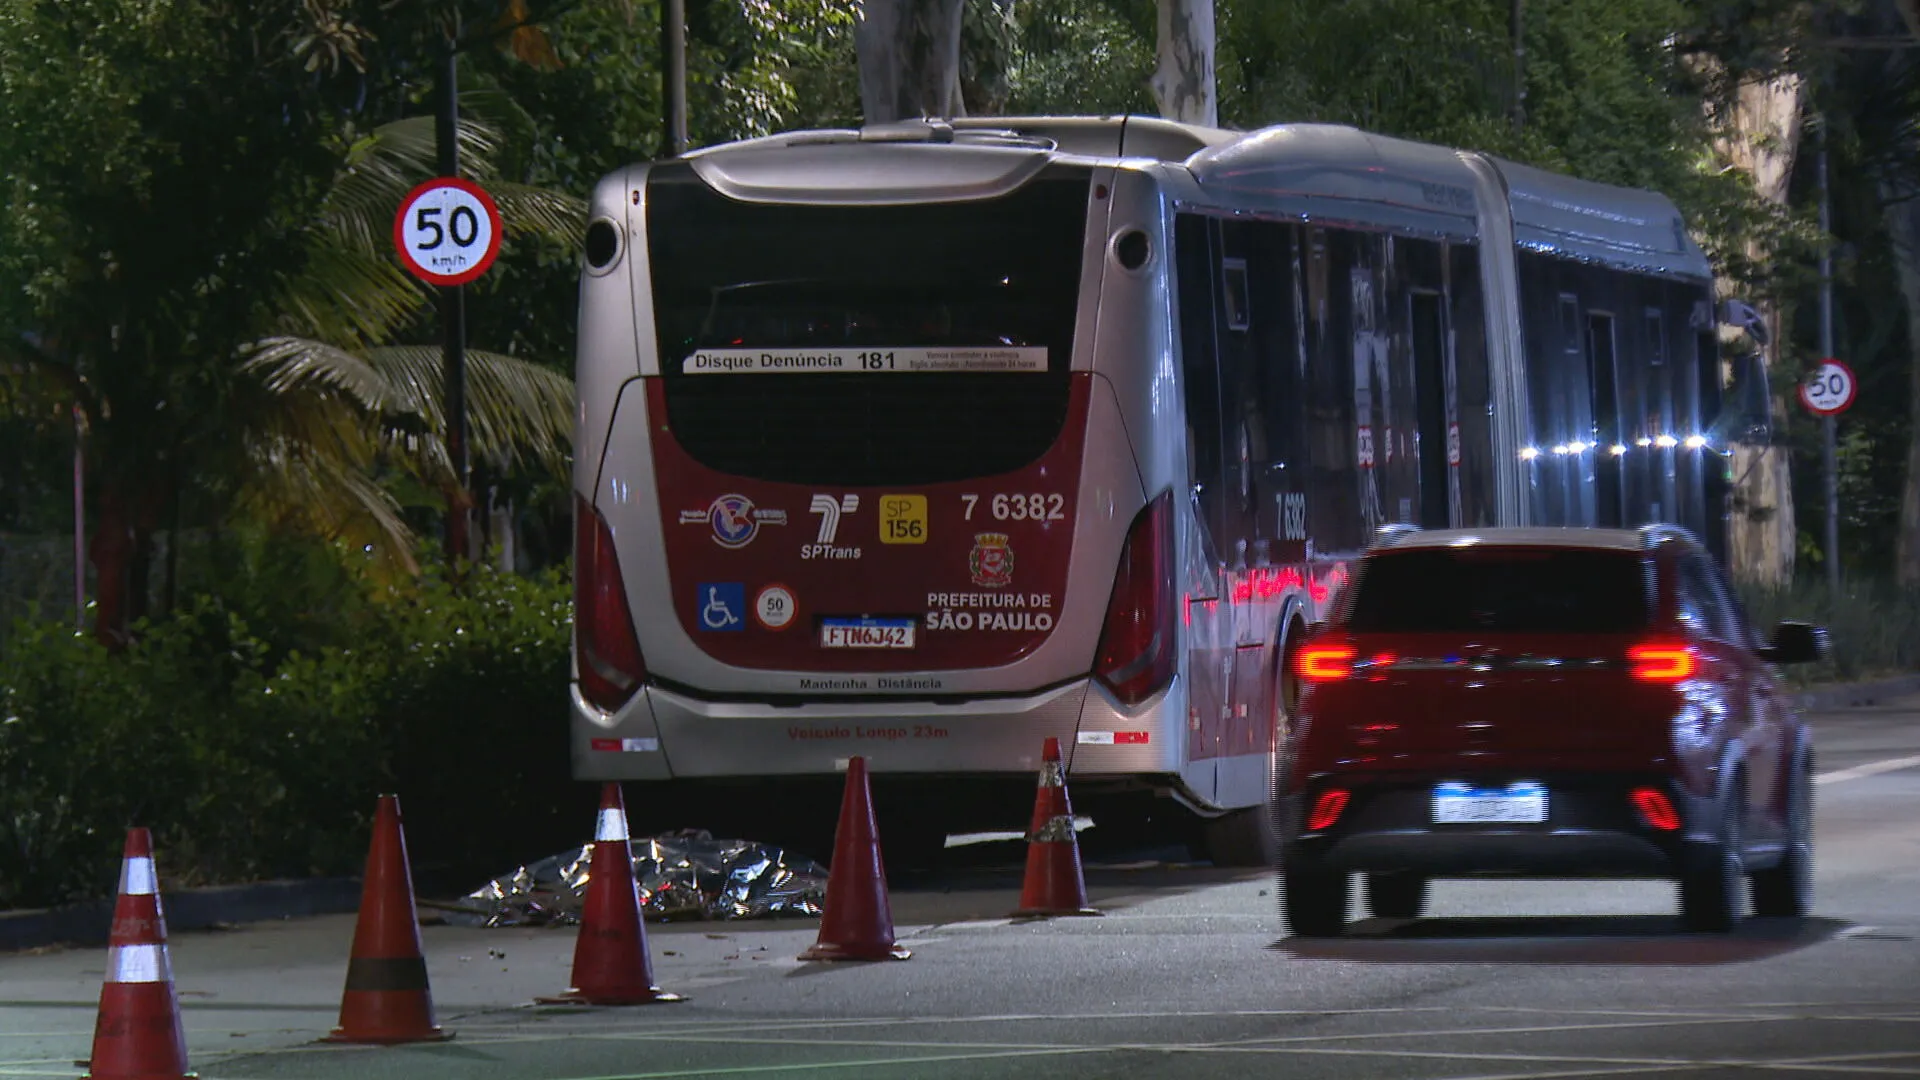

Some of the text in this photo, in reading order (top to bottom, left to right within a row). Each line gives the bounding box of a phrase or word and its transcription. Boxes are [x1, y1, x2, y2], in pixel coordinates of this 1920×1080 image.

[417, 205, 478, 250] 50
[431, 255, 466, 266] km/h
[696, 354, 753, 370] Disque
[760, 353, 843, 368] Denúncia
[857, 352, 895, 369] 181
[1811, 373, 1844, 397] 50
[887, 500, 912, 517] SP
[961, 493, 1065, 521] 7 6382
[887, 519, 922, 538] 156
[801, 545, 861, 560] SPTrans
[767, 597, 784, 611] 50
[927, 593, 1052, 608] PREFEITURA DE
[926, 608, 1053, 631] SÃO PAULO
[829, 627, 906, 645] FTN6J42
[800, 678, 942, 690] Mantenha Distância
[913, 725, 949, 738] 23m
